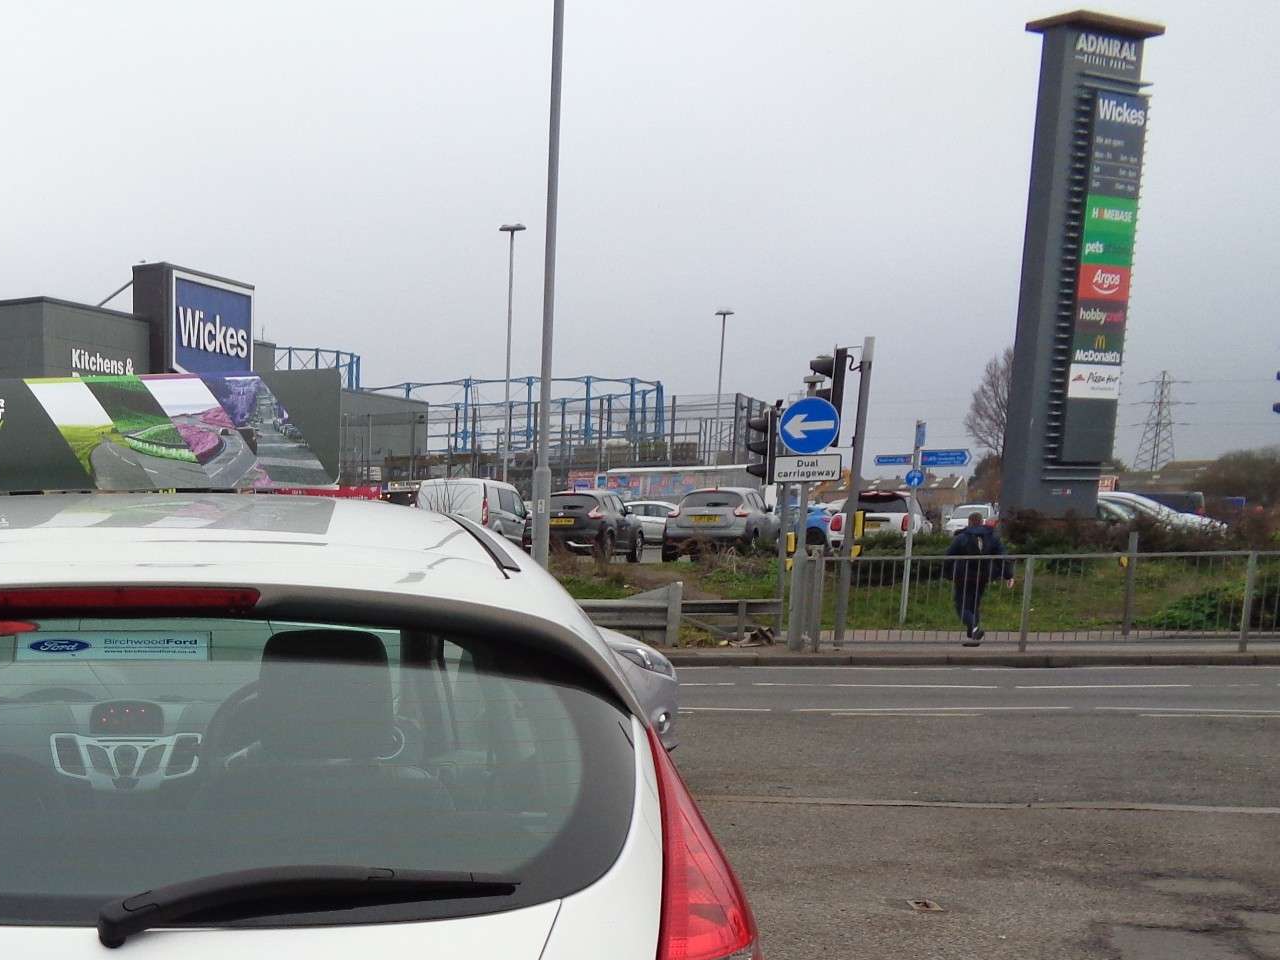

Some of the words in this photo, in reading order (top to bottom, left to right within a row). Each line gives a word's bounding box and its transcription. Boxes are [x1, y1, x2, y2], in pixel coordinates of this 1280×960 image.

[1075, 32, 1137, 61] ADMIRAL
[1099, 98, 1145, 126] Wickes
[1092, 269, 1121, 288] Argos
[178, 305, 248, 359] Wickes
[71, 348, 124, 375] Kitchens
[125, 357, 134, 375] &
[777, 470, 836, 478] carriageway
